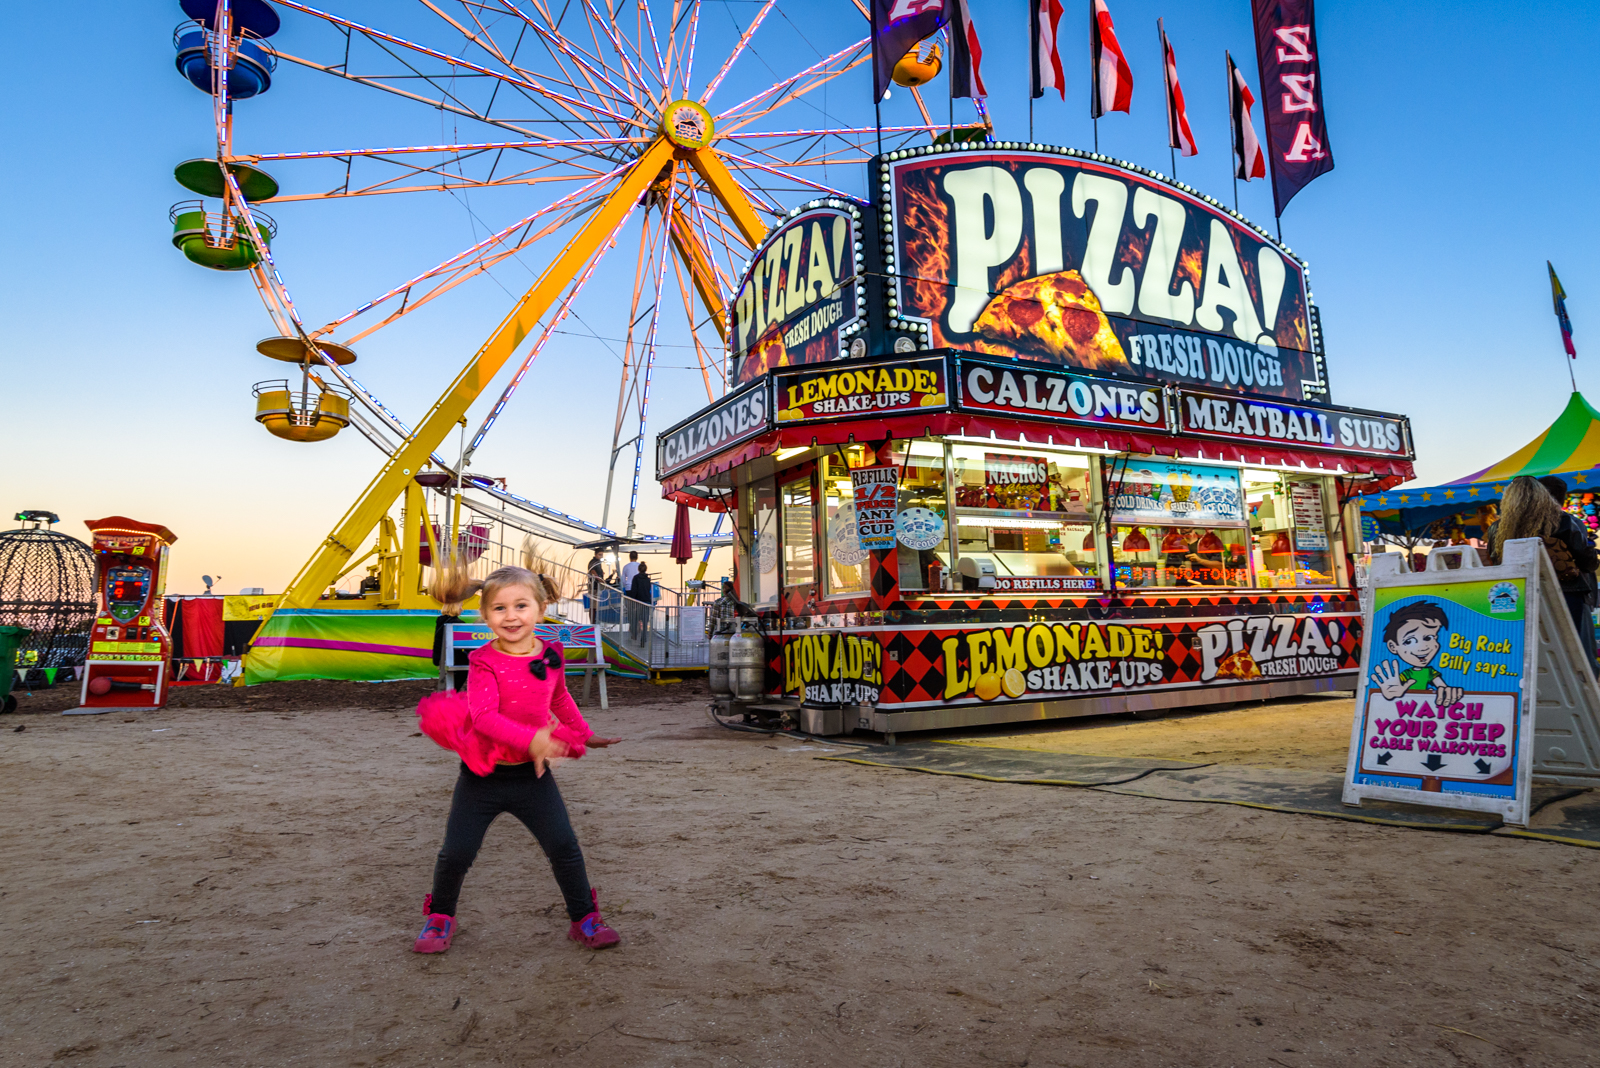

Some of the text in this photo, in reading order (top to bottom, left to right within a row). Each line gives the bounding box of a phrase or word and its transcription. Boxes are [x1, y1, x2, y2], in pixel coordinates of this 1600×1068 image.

[943, 166, 1286, 357] PIZZA!
[736, 216, 847, 377] PIZZA!
[784, 301, 844, 350] FRESH DOUGH
[1129, 333, 1284, 387] FRESH DOUGH
[787, 368, 938, 410] LEMONADE!
[967, 367, 1160, 424] CALZONES
[812, 392, 911, 414] SHAKE-UPS
[665, 390, 765, 468] CALZONES
[1187, 397, 1401, 452] MEATBALL SUBS
[852, 468, 898, 487] REFILLS
[988, 462, 1047, 485] NACHOS
[854, 484, 897, 500] 1/2
[855, 499, 896, 511] PRICE
[1115, 495, 1135, 509] COLD
[1135, 496, 1163, 511] DRINKS
[1203, 502, 1237, 515] ICE COLD
[858, 509, 895, 522] ANY
[859, 523, 895, 536] CUP
[901, 534, 915, 547] ICE
[833, 546, 846, 562] ICE
[994, 579, 1096, 590] DO REFILLS HERE!
[1197, 617, 1342, 682] PIZZA!
[1449, 633, 1512, 654] Big Rock
[942, 623, 1165, 700] LEMONADE!
[1261, 657, 1339, 676] FRESH DOUGH
[1439, 652, 1518, 678] Billy says...
[1026, 661, 1164, 691] SHAKE-UPS
[805, 682, 879, 702] SHAKE-UPS
[1395, 700, 1483, 720] WATCH
[1374, 718, 1505, 742] YOUR STEP
[1369, 736, 1507, 757] CABLE WALKOVERS
